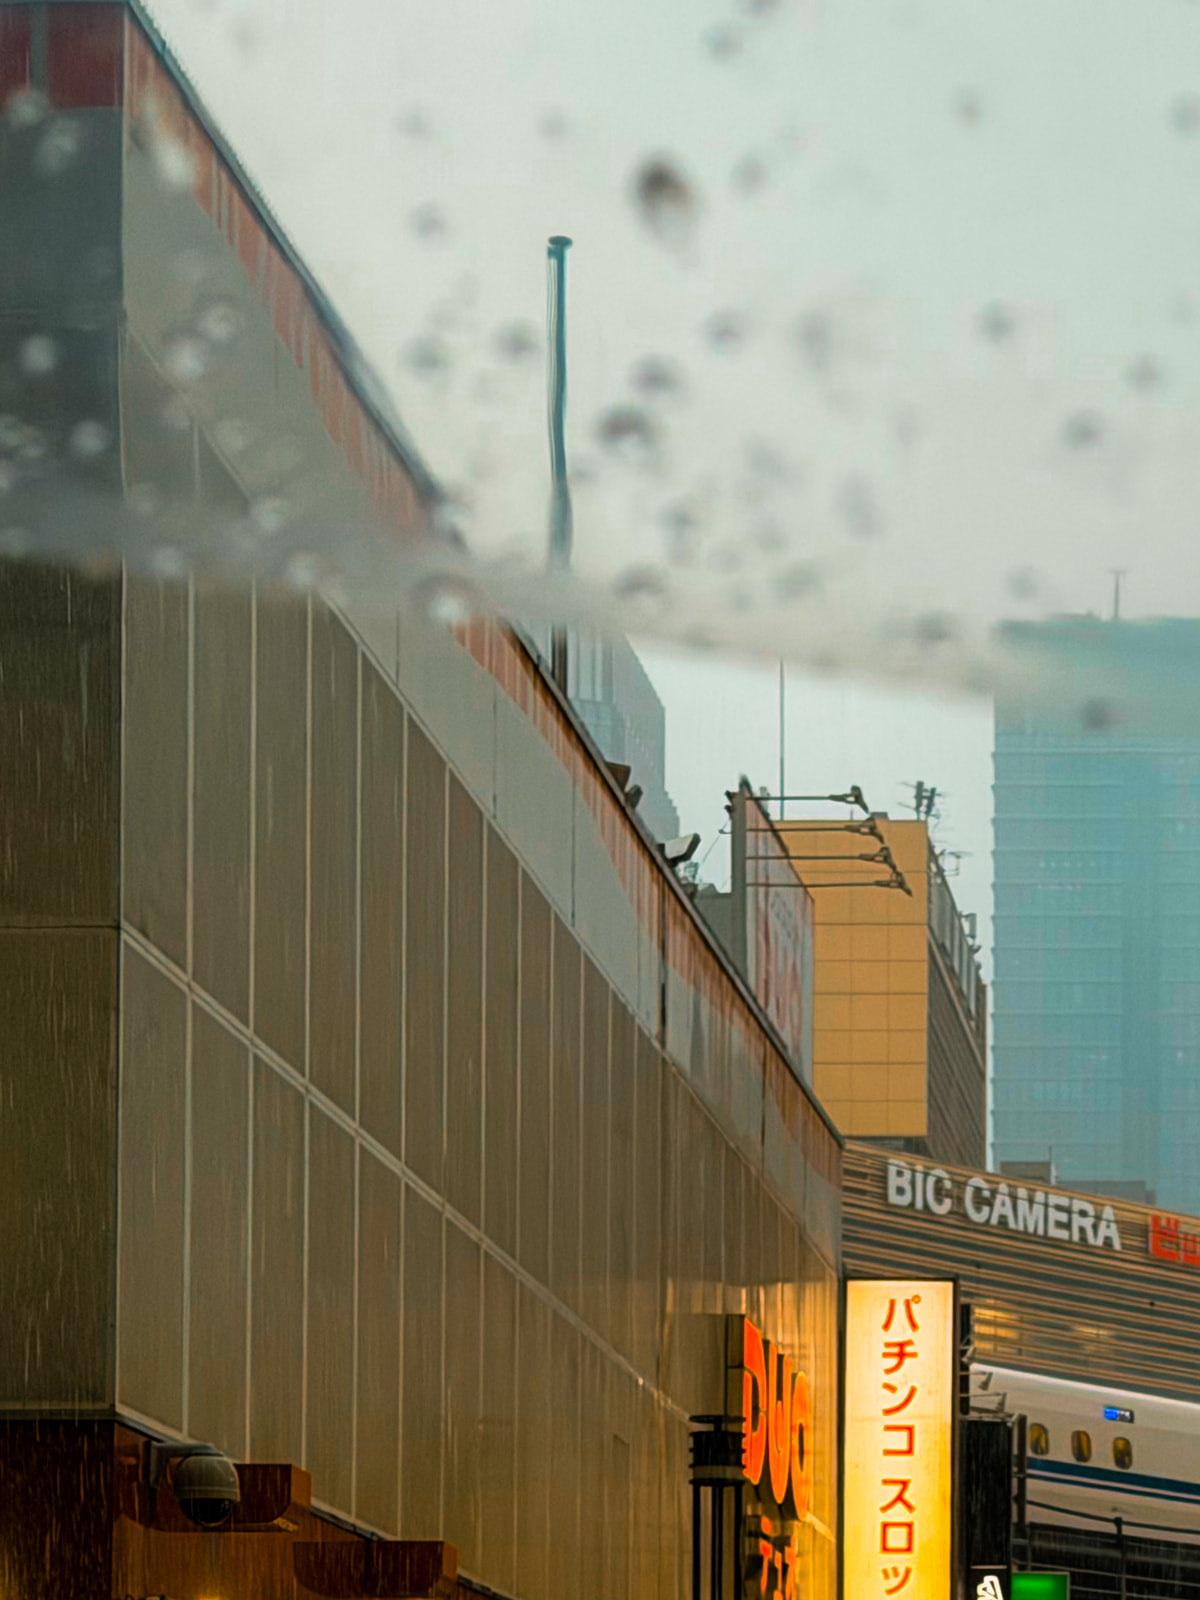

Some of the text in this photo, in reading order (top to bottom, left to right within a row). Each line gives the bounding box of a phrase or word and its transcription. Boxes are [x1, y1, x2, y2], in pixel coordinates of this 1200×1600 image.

[886, 1158, 1122, 1250] BIC CAMERA
[741, 1315, 813, 1523] DUO
[881, 1294, 922, 1457] パチンコ
